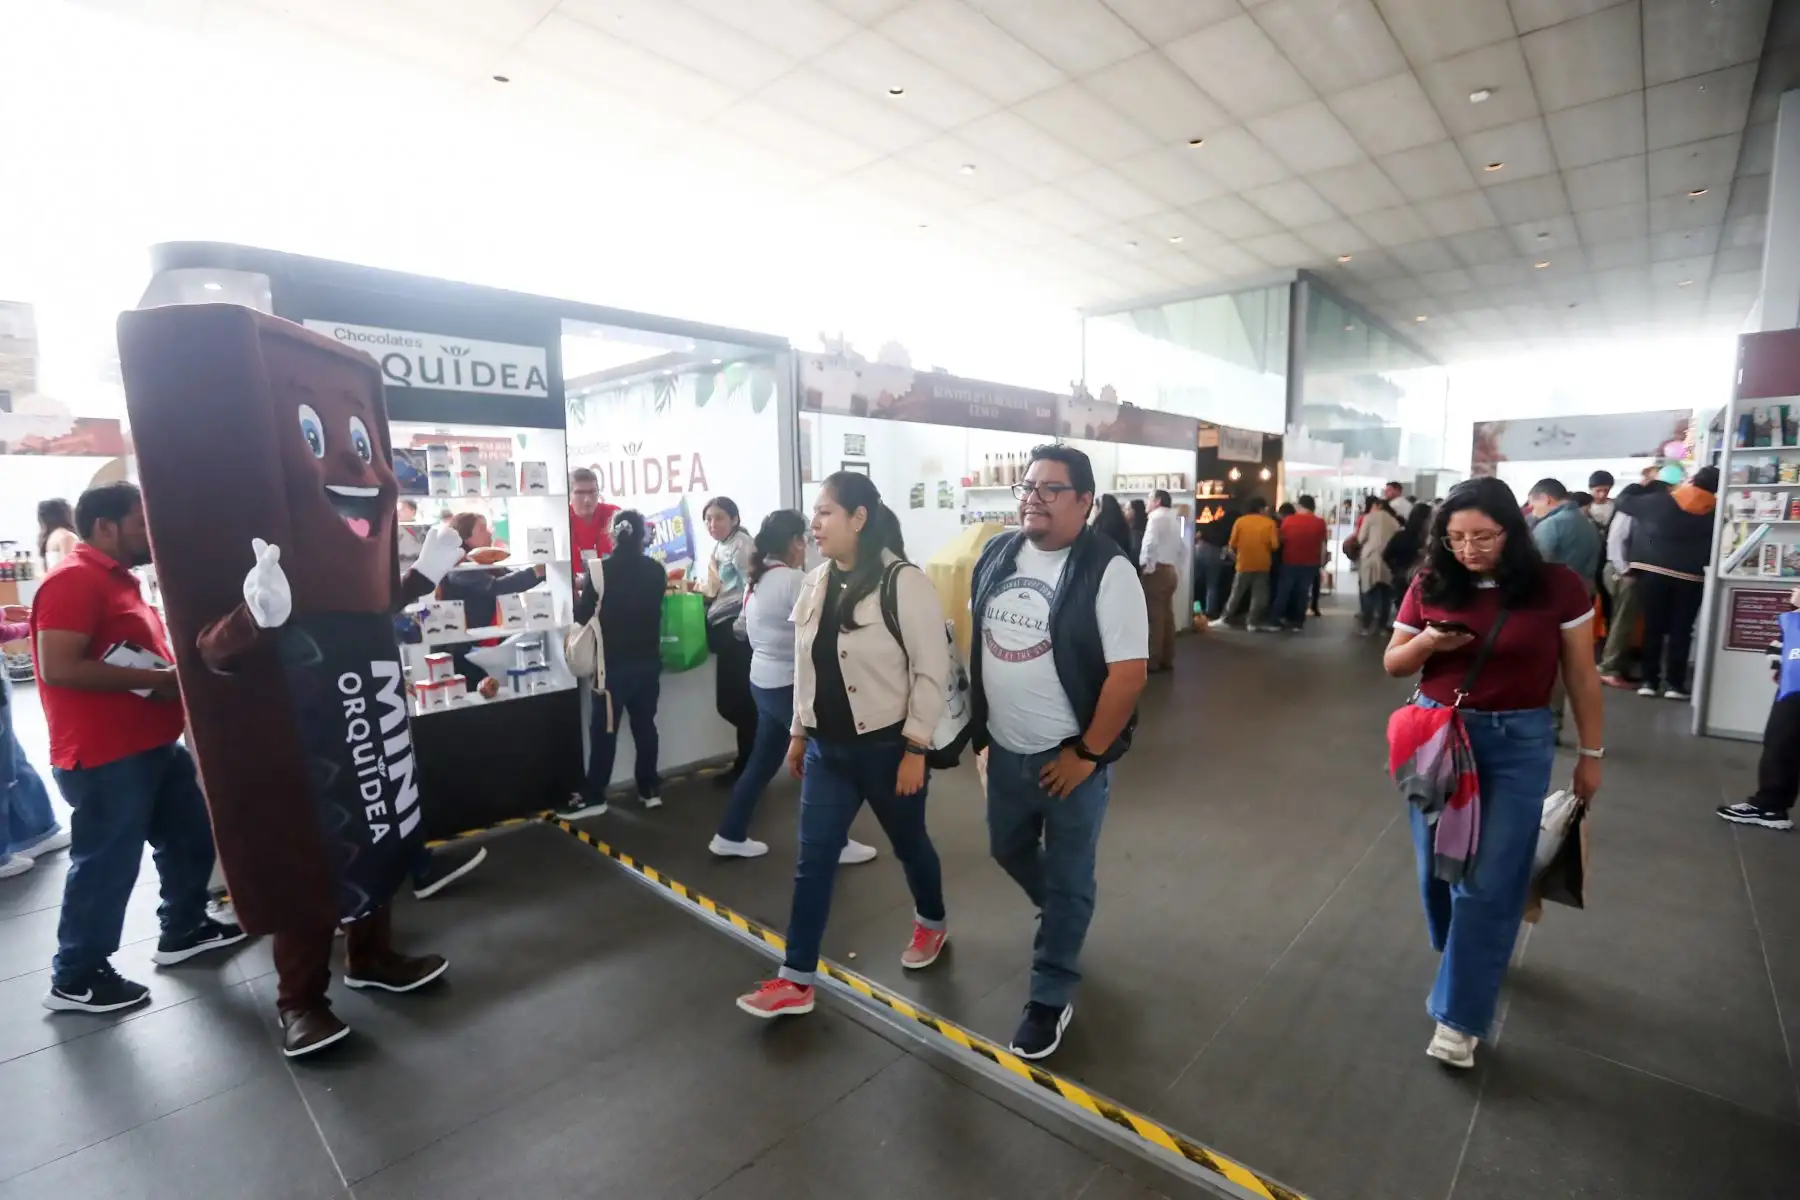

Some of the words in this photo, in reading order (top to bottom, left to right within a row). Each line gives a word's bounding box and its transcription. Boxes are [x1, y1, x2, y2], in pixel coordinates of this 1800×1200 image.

[334, 327, 423, 349] Chocolates
[381, 352, 548, 391] QUIDEA
[370, 660, 422, 839] MINI
